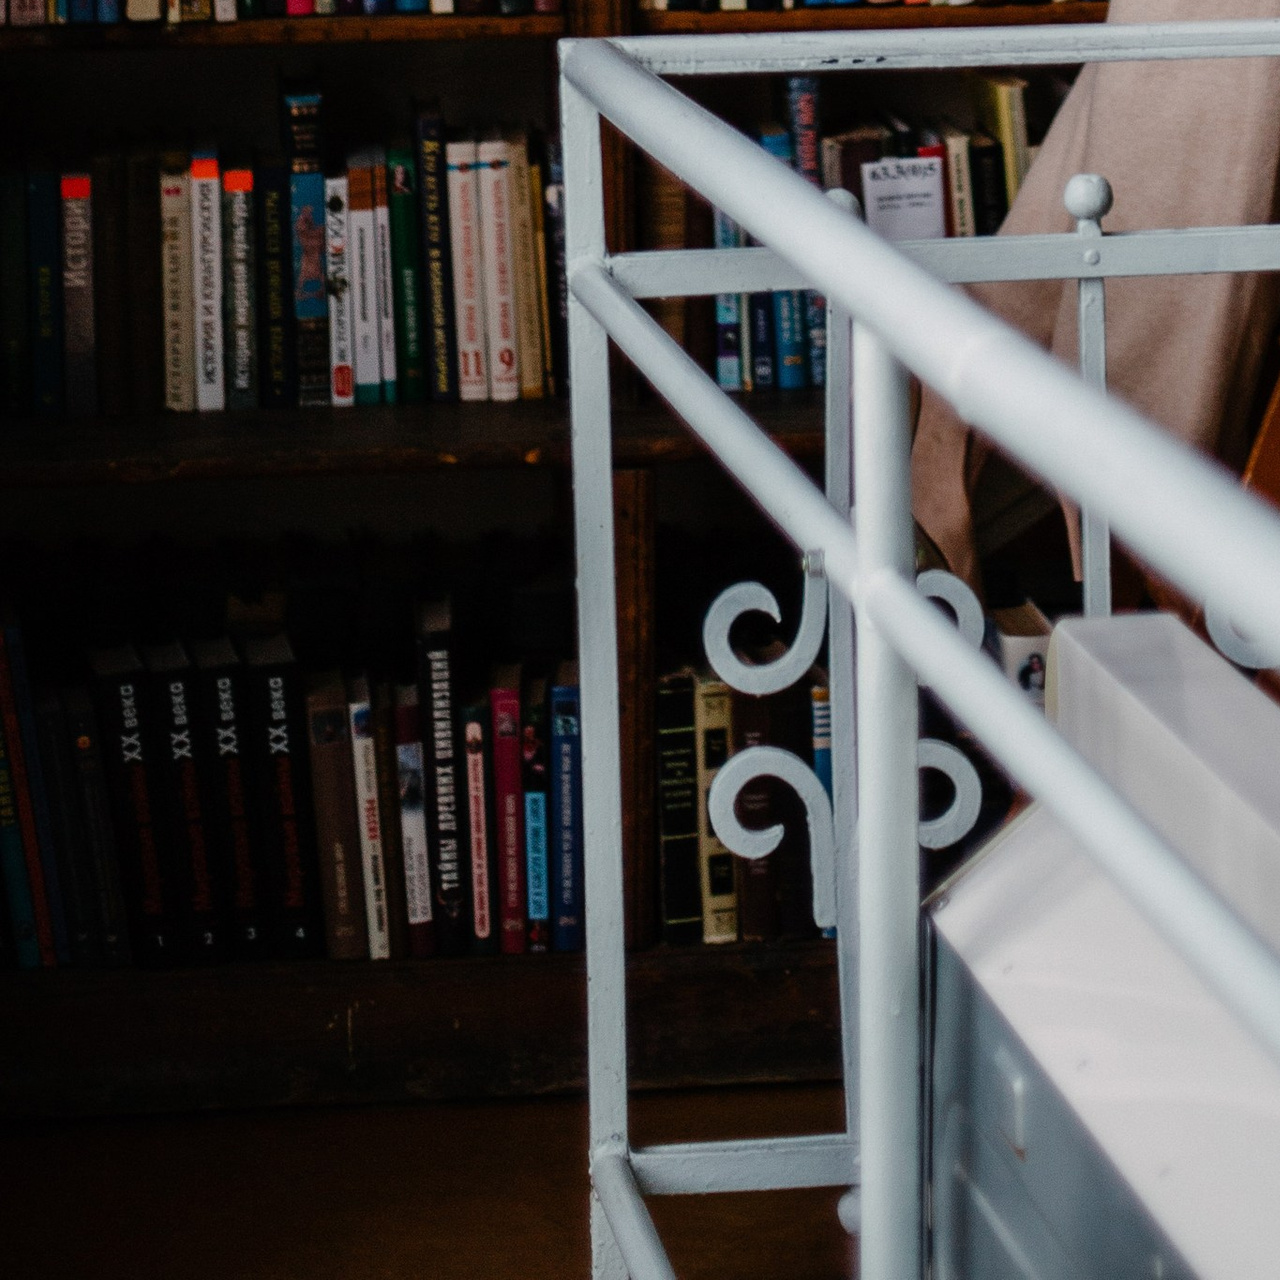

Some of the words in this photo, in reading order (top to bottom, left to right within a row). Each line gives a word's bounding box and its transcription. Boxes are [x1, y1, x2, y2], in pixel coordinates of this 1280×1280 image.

[62, 199, 87, 288] Истори
[198, 182, 214, 301] КУЛЬТУРОЛОГИЯ
[200, 306, 214, 316] И
[202, 322, 217, 384] ИСТОРИЯ
[119, 684, 138, 728] века
[169, 681, 188, 725] века
[216, 677, 235, 721] века
[268, 677, 287, 720] века
[426, 649, 454, 760] ЦИВИЛИЗАЦИЙ
[435, 765, 458, 832] ДРЕВНИХ
[435, 837, 460, 891] ТАЙНЫ
